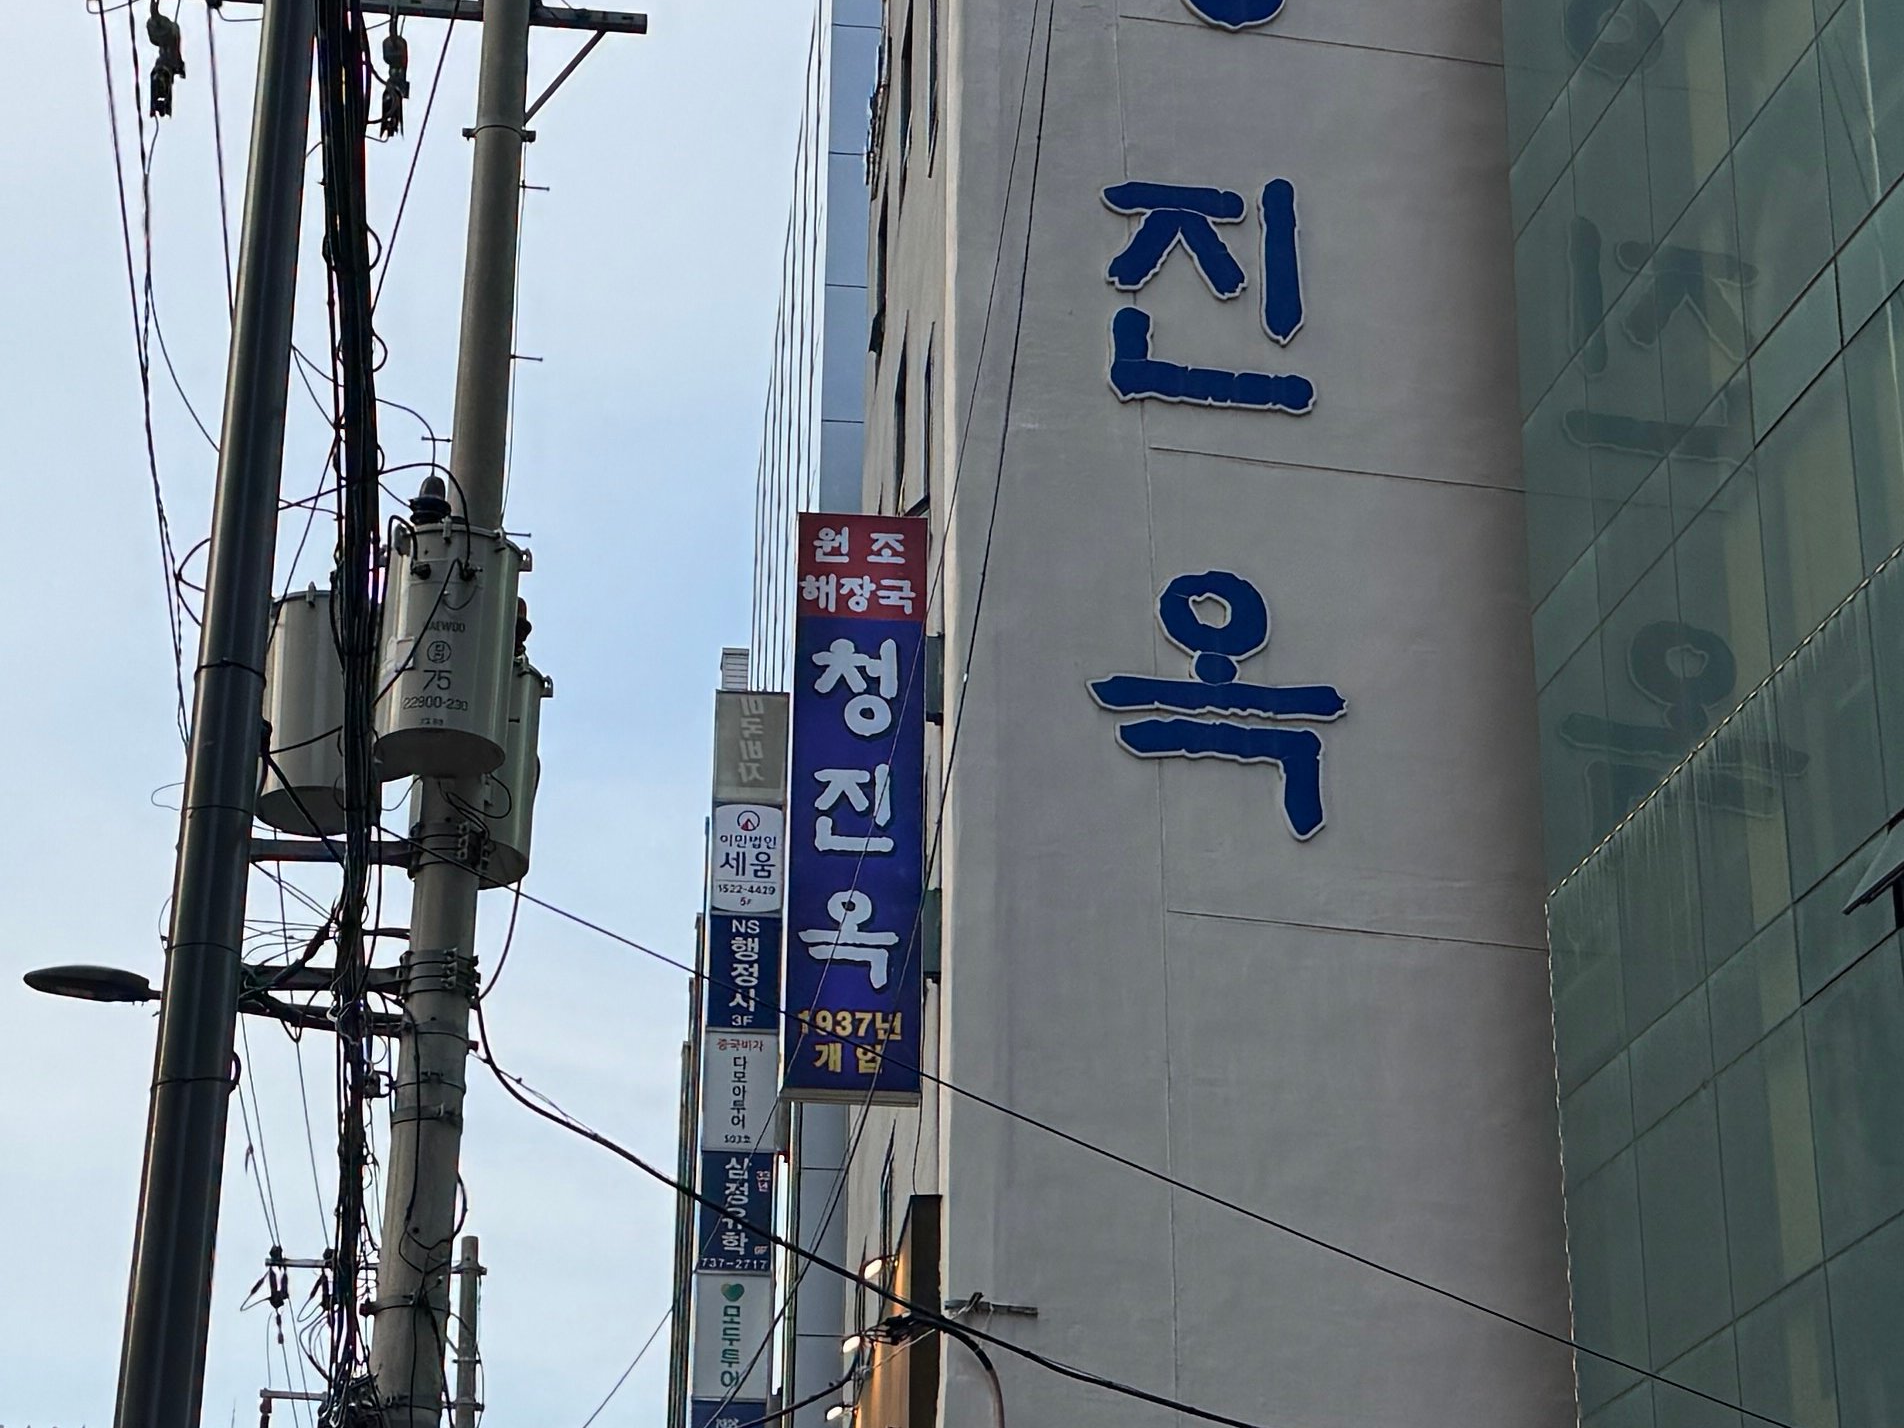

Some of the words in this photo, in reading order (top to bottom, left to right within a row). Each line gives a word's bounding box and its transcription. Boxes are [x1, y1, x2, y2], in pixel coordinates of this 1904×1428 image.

[813, 527, 906, 565] 원조
[799, 575, 917, 614] 해장국
[798, 639, 899, 990] 청진옥
[720, 834, 777, 850] 이민법인
[720, 851, 776, 879] 세움
[731, 919, 760, 934] NS
[729, 937, 760, 1012] 행정사
[732, 1015, 754, 1026] 3F
[798, 1009, 902, 1041] 1937년
[701, 1258, 768, 1270] 737-2717
[720, 1306, 742, 1388] 모두투어
